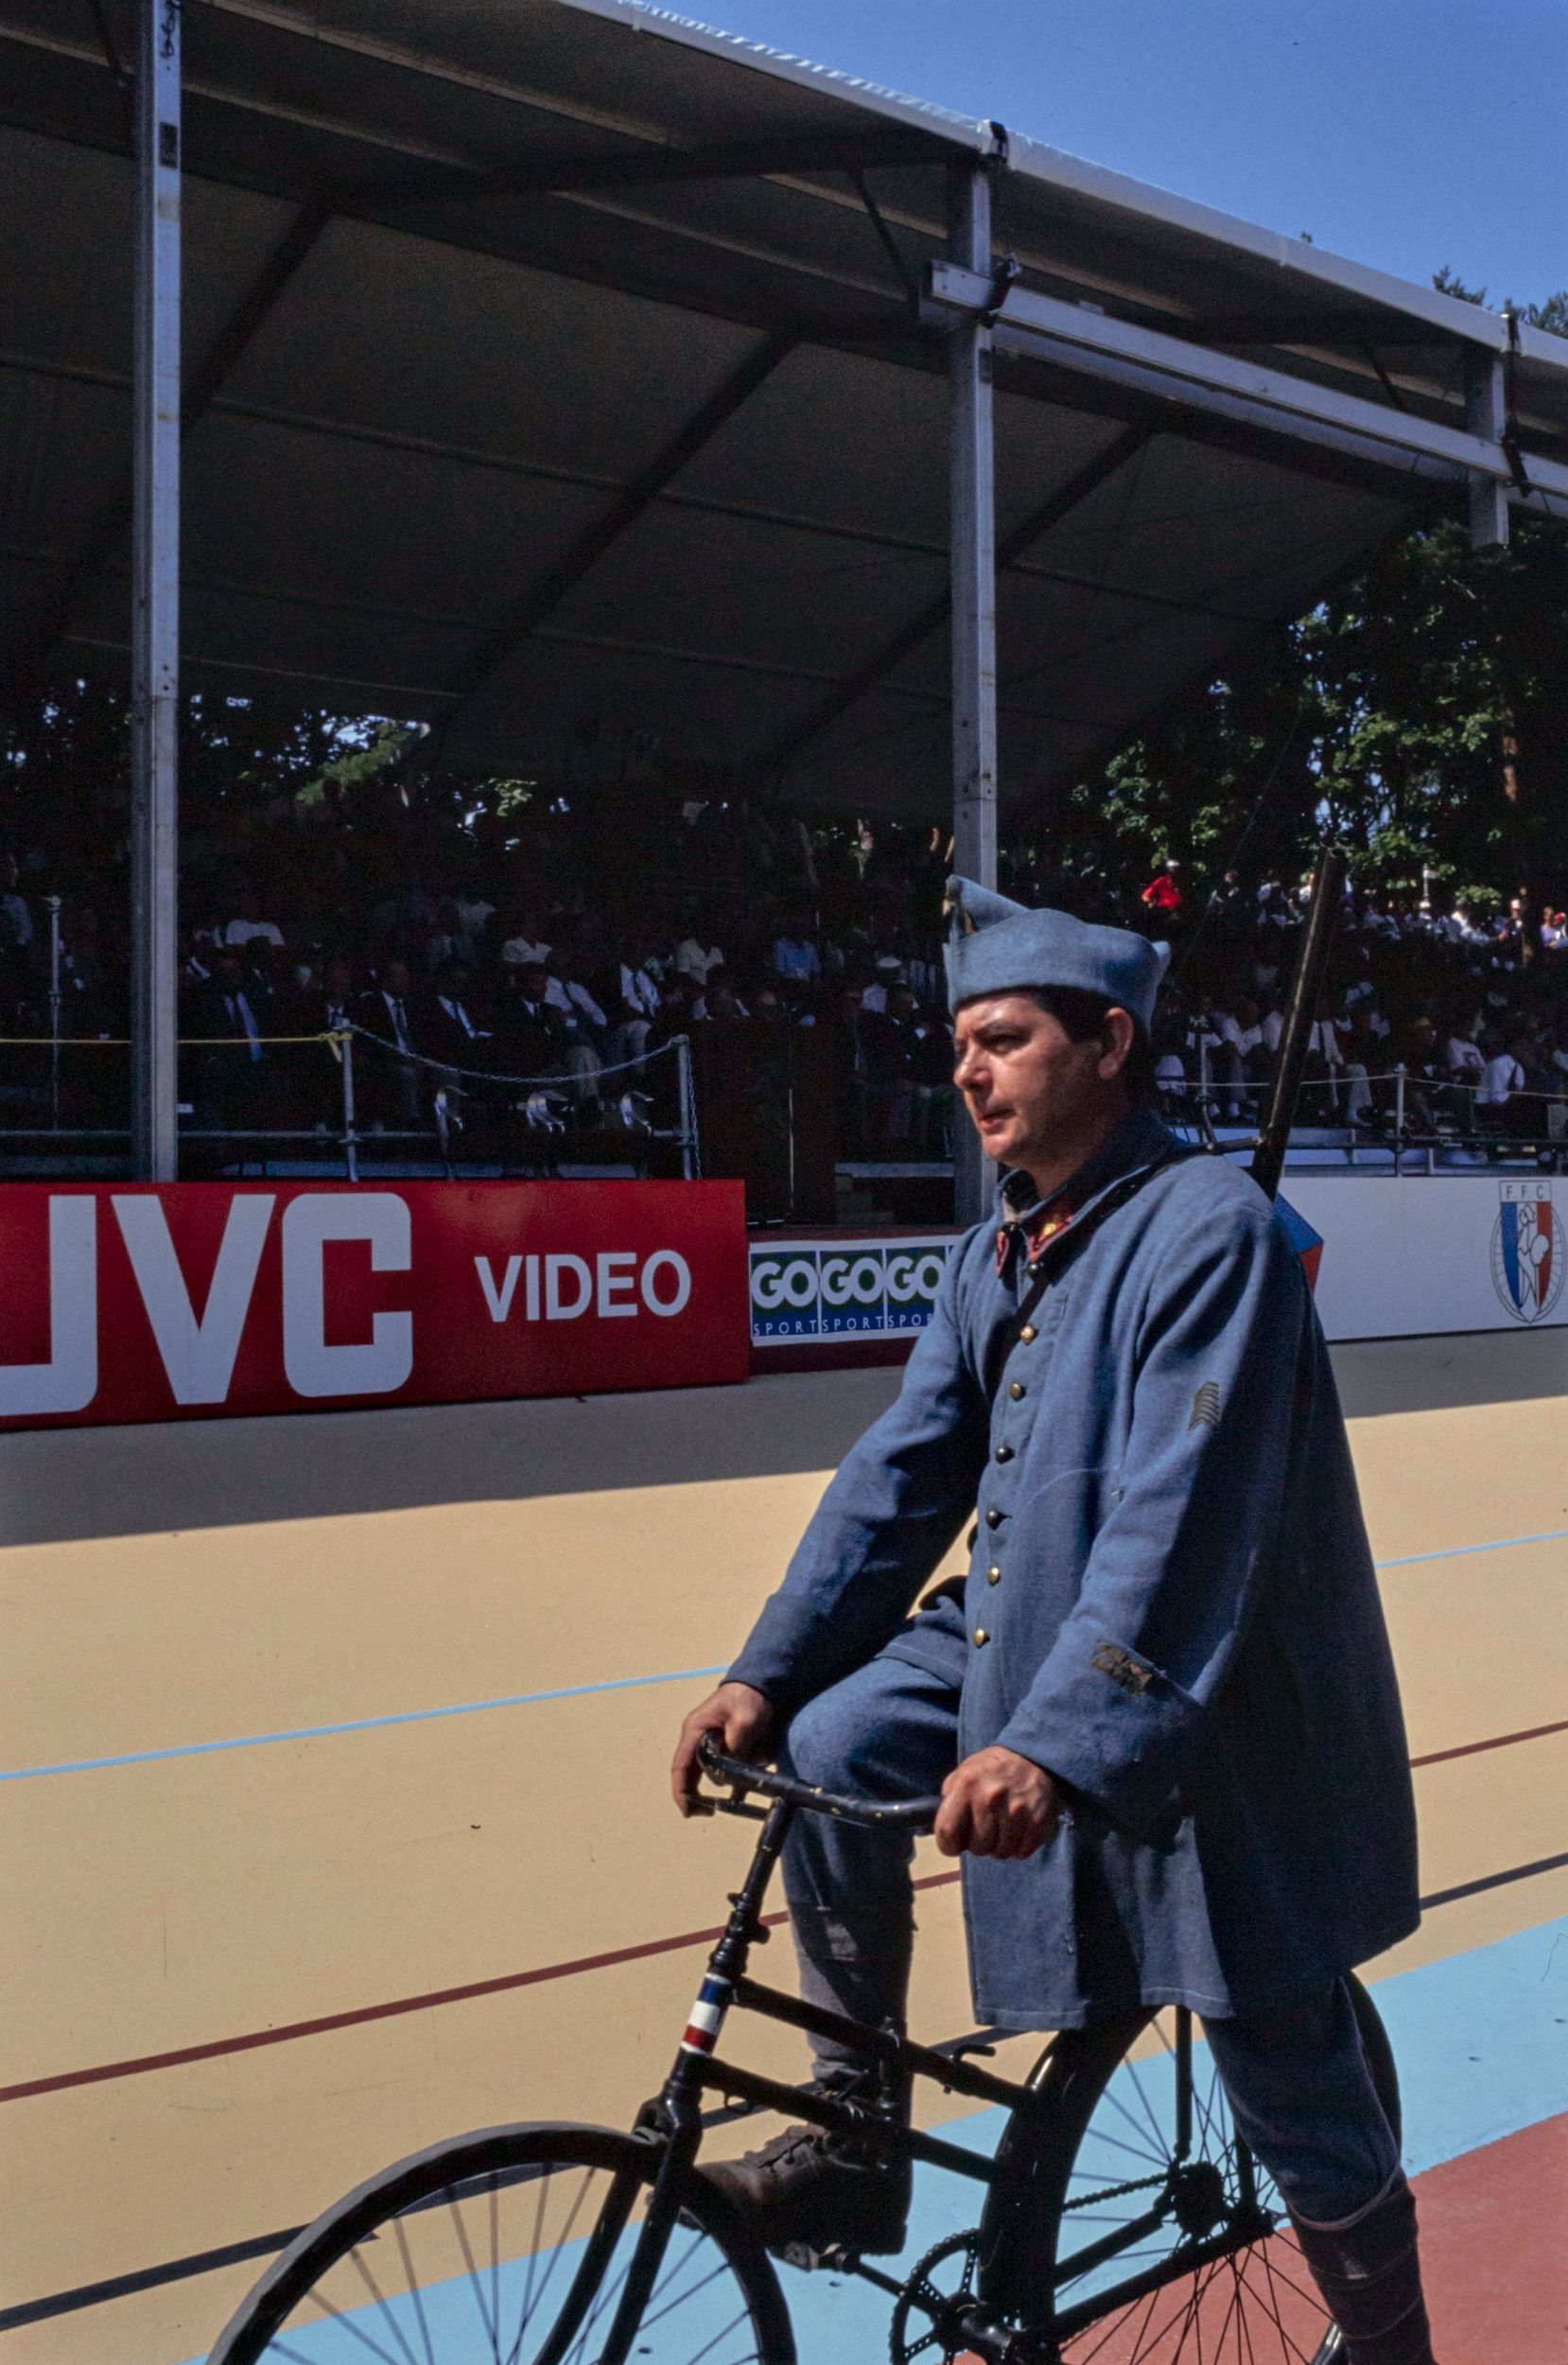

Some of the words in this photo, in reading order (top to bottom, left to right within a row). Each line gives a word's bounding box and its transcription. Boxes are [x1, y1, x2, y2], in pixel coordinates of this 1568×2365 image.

[0, 1192, 413, 1415] JVC
[475, 1250, 691, 1323] VIDEO
[751, 1261, 818, 1309] GO
[821, 1258, 884, 1305] GO
[886, 1254, 946, 1302] GO
[753, 1320, 817, 1337] SPORT
[822, 1316, 884, 1332] SPORT
[888, 1312, 934, 1328] SPOR
